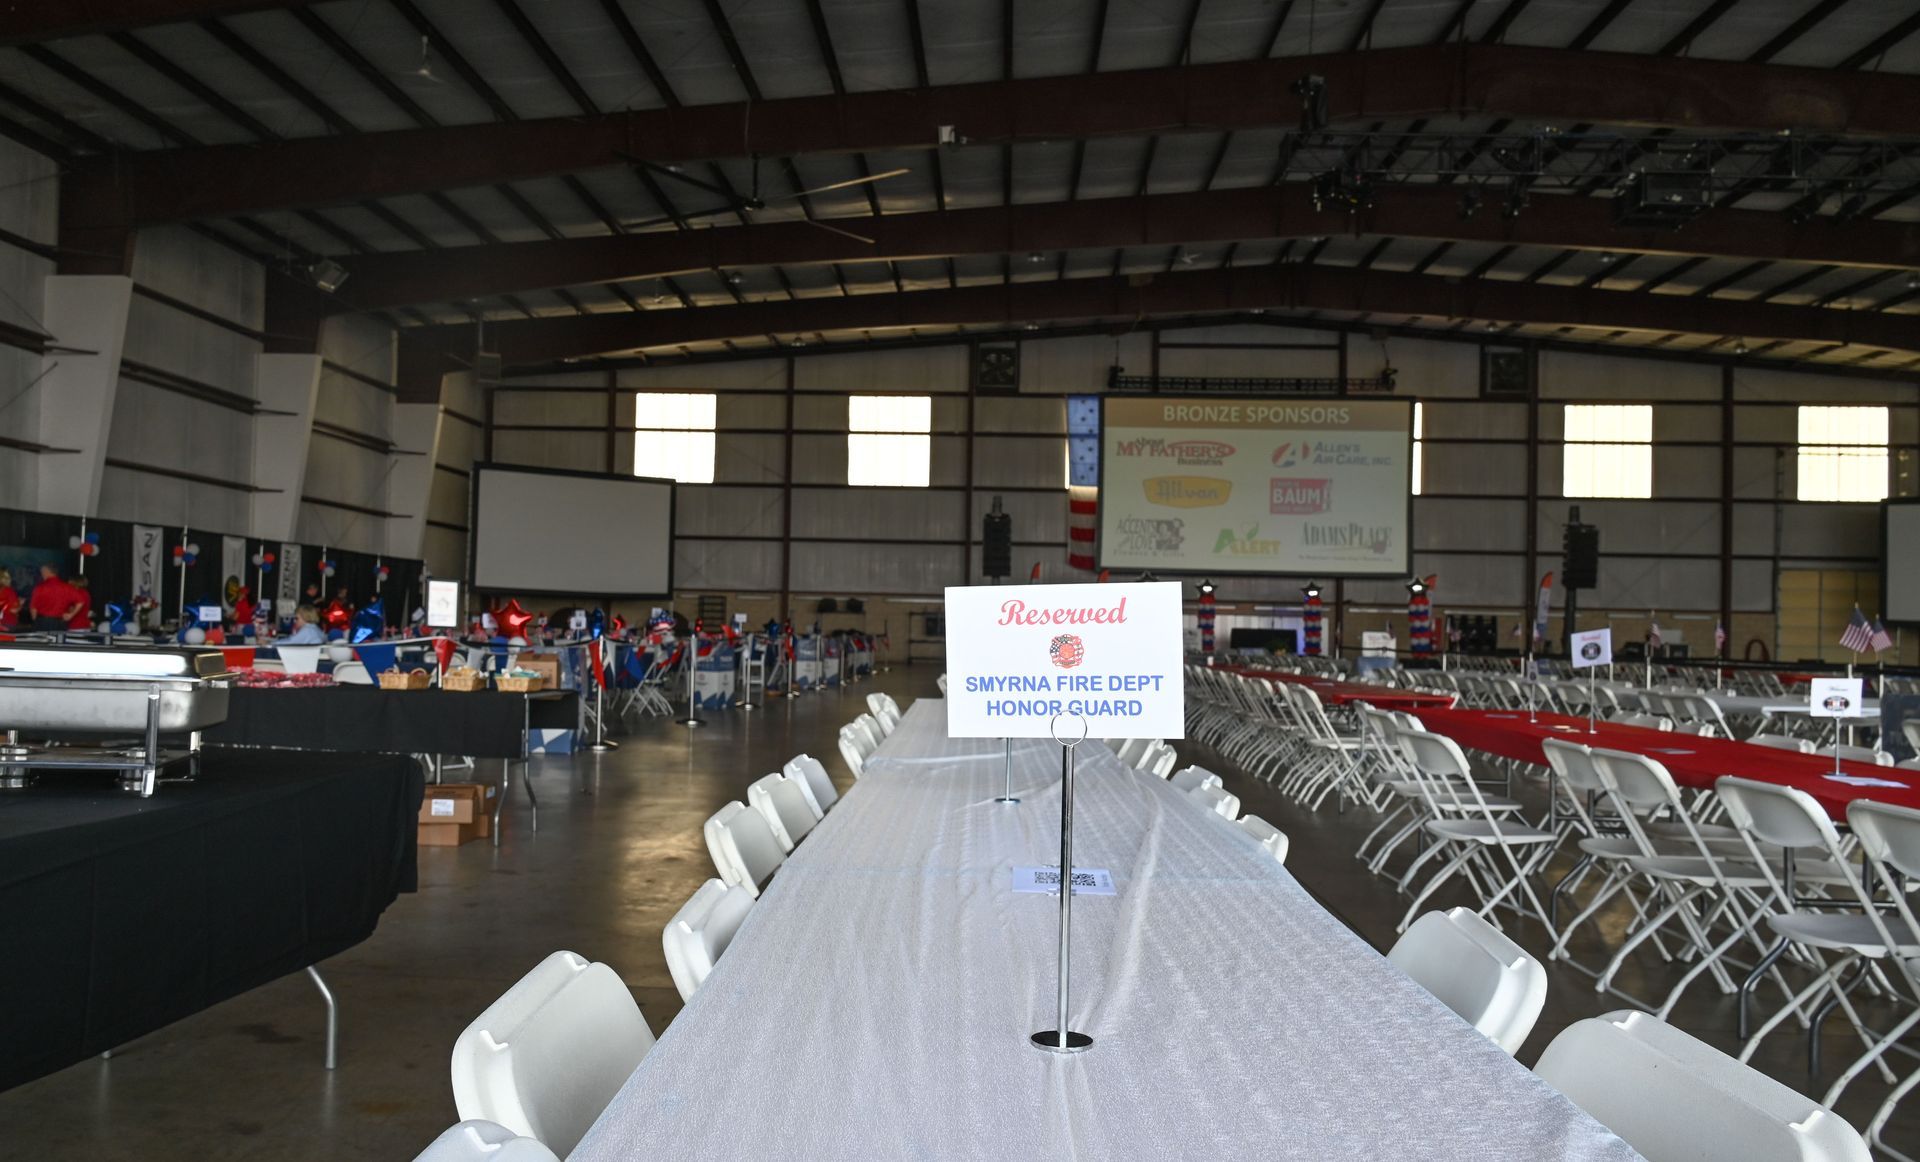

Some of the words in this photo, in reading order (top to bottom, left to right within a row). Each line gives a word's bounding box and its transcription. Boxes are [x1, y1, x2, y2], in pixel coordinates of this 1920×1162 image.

[1163, 405, 1240, 423] BRONZE
[1246, 406, 1350, 424] SPONSORS
[1116, 441, 1143, 456] MY
[1149, 444, 1227, 457] FATHER'S
[997, 596, 1128, 626] Reserved
[965, 675, 1051, 693] SMYRNA
[1057, 674, 1103, 692] FIRE
[1109, 674, 1164, 692] DEPT
[986, 699, 1062, 717] HONOR
[1067, 699, 1143, 717] GUARD
